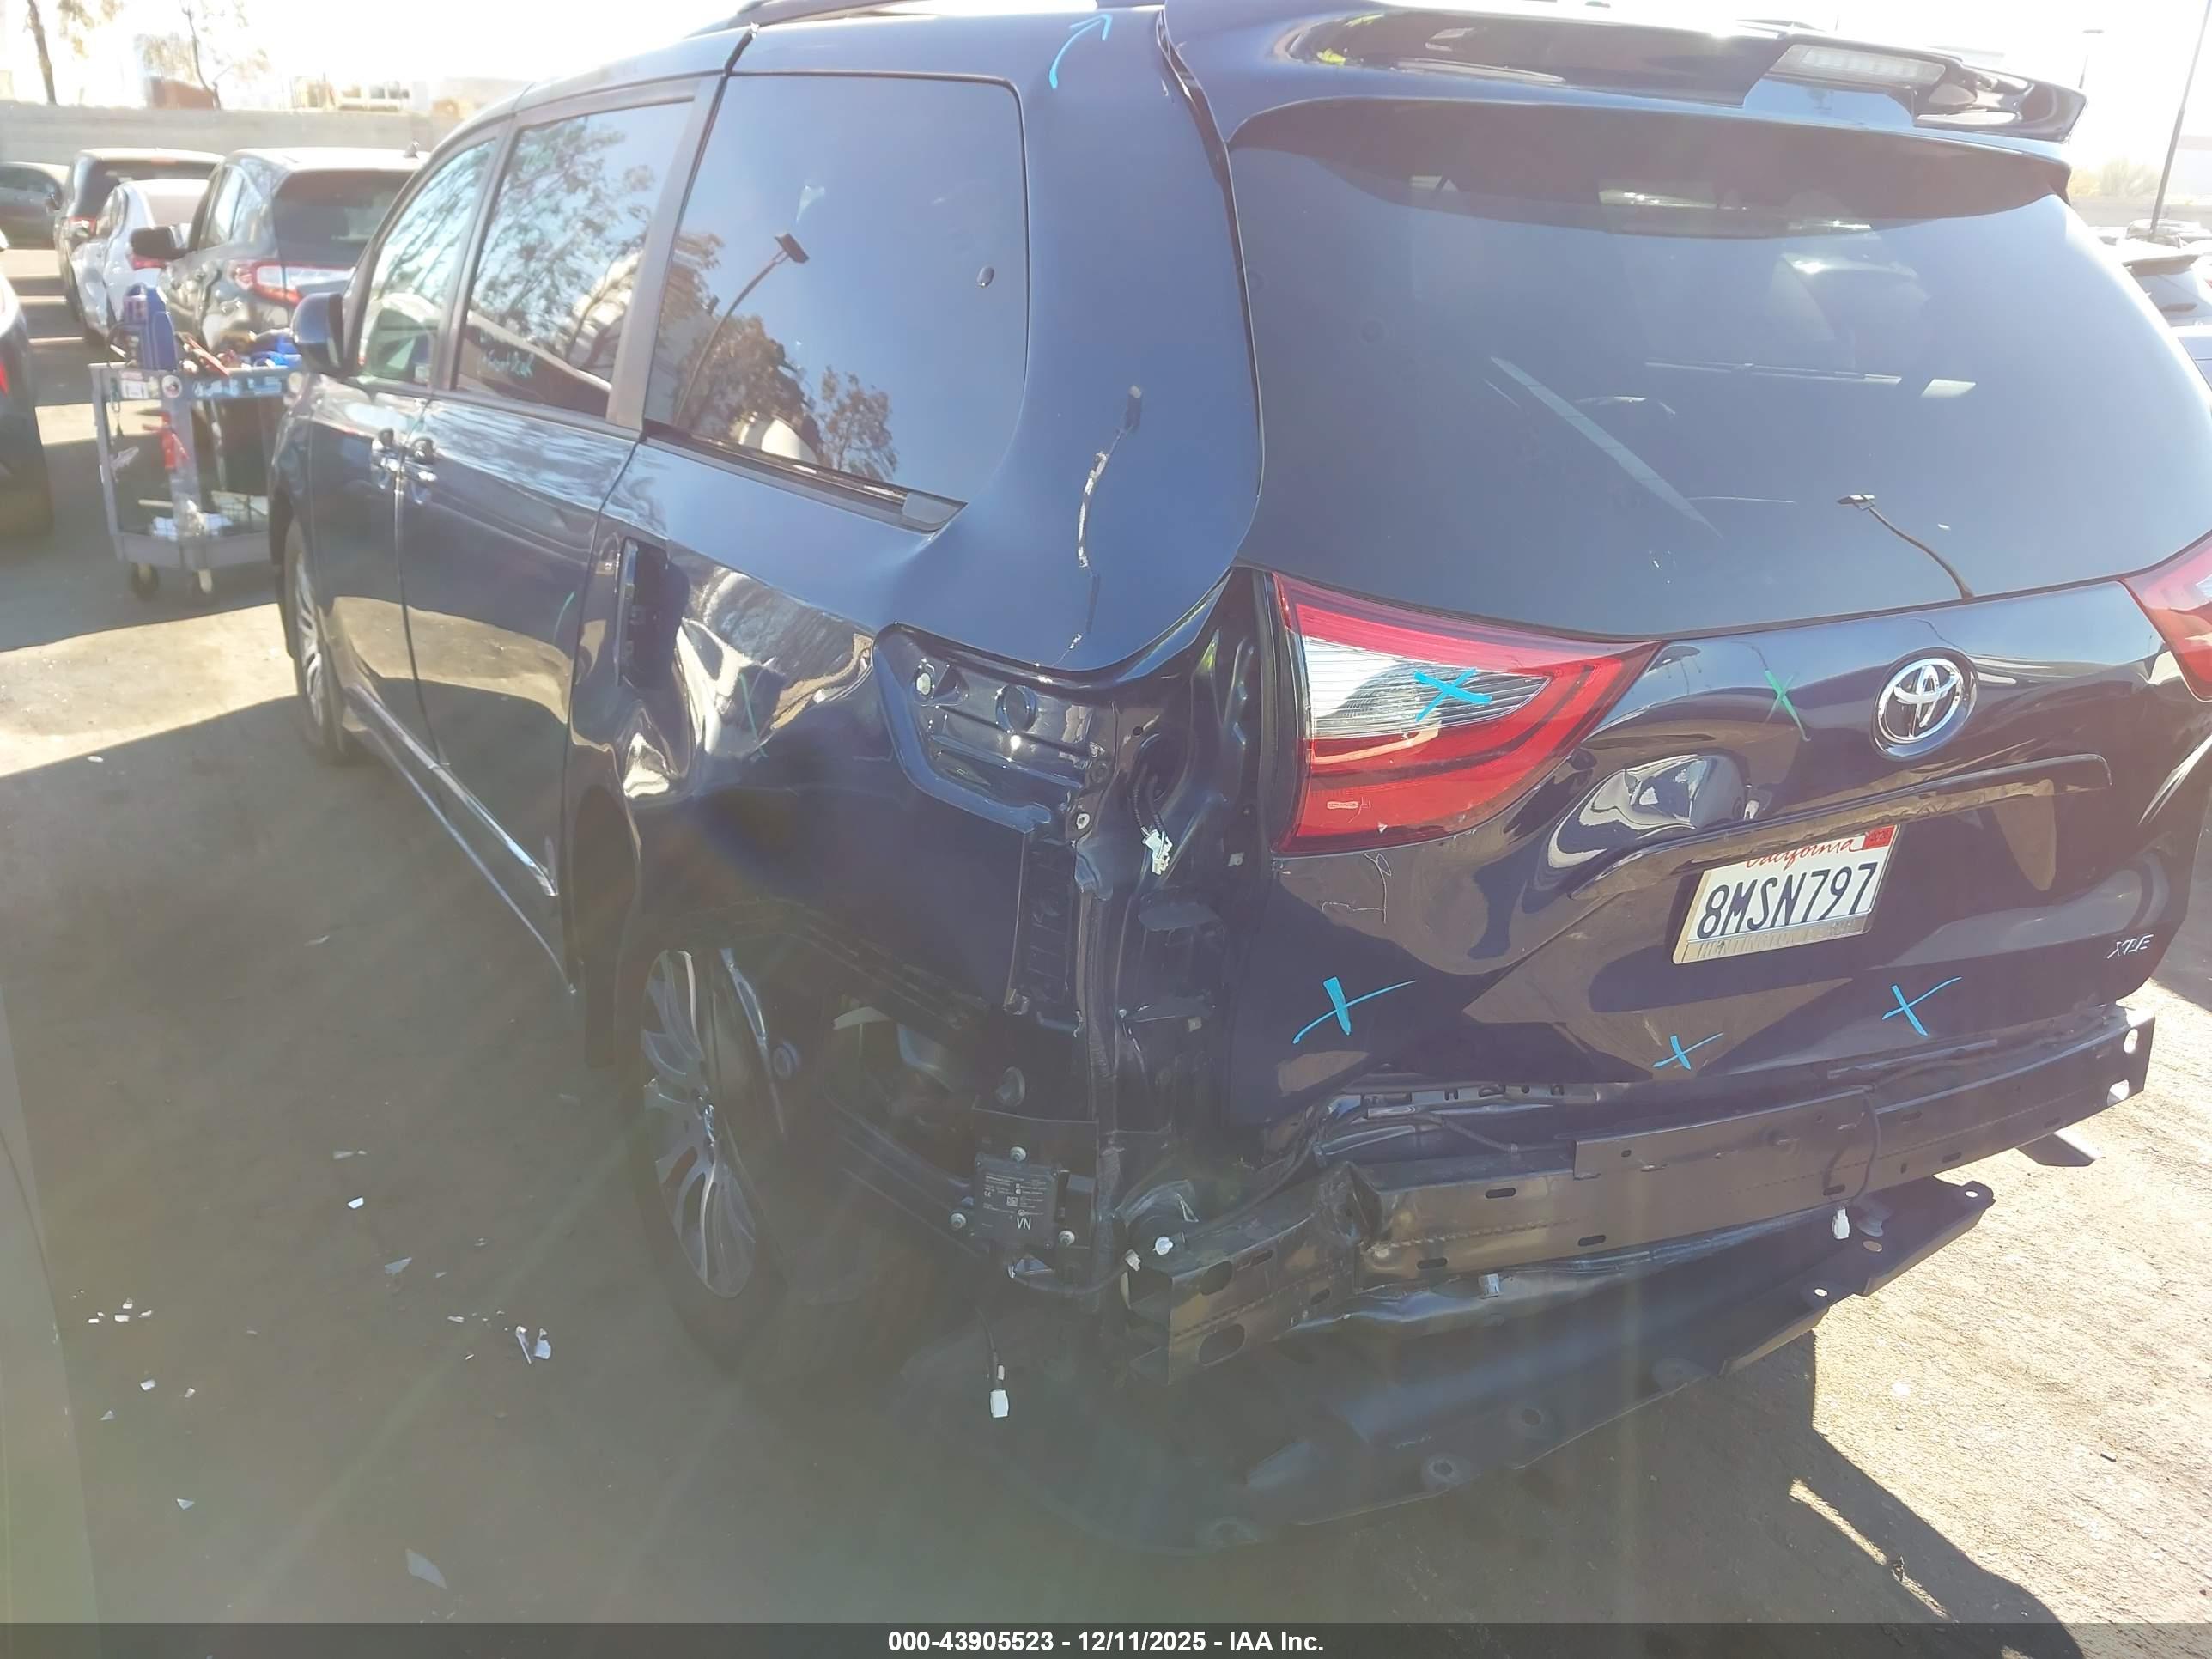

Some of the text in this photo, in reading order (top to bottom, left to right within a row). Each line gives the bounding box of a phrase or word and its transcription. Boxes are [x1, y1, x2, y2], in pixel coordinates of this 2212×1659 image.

[1697, 861, 1878, 939] 8MSN797
[2107, 934, 2154, 959] XLE
[1016, 1216, 1031, 1231] VN
